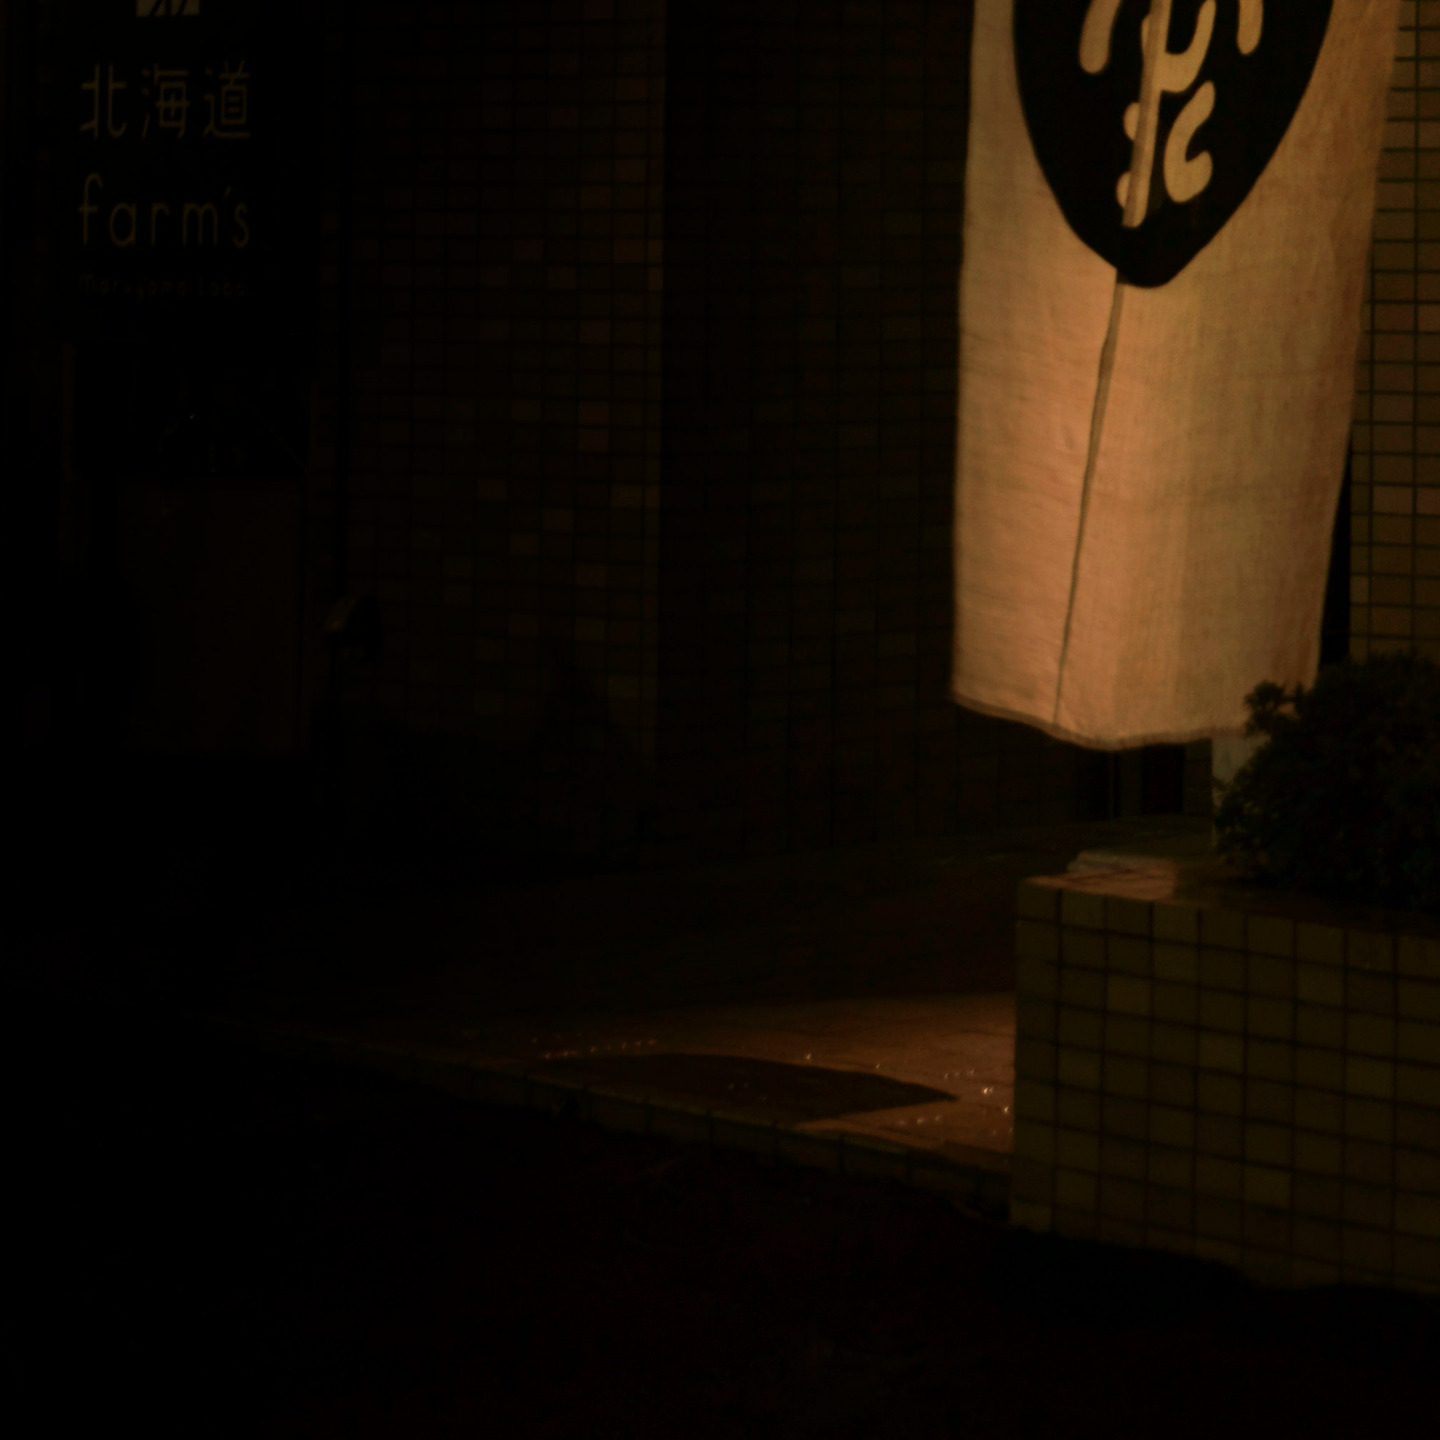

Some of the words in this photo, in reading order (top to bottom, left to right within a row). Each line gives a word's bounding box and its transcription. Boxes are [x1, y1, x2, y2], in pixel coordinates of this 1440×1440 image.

[78, 58, 253, 141] 北海道
[77, 172, 251, 250] farm's
